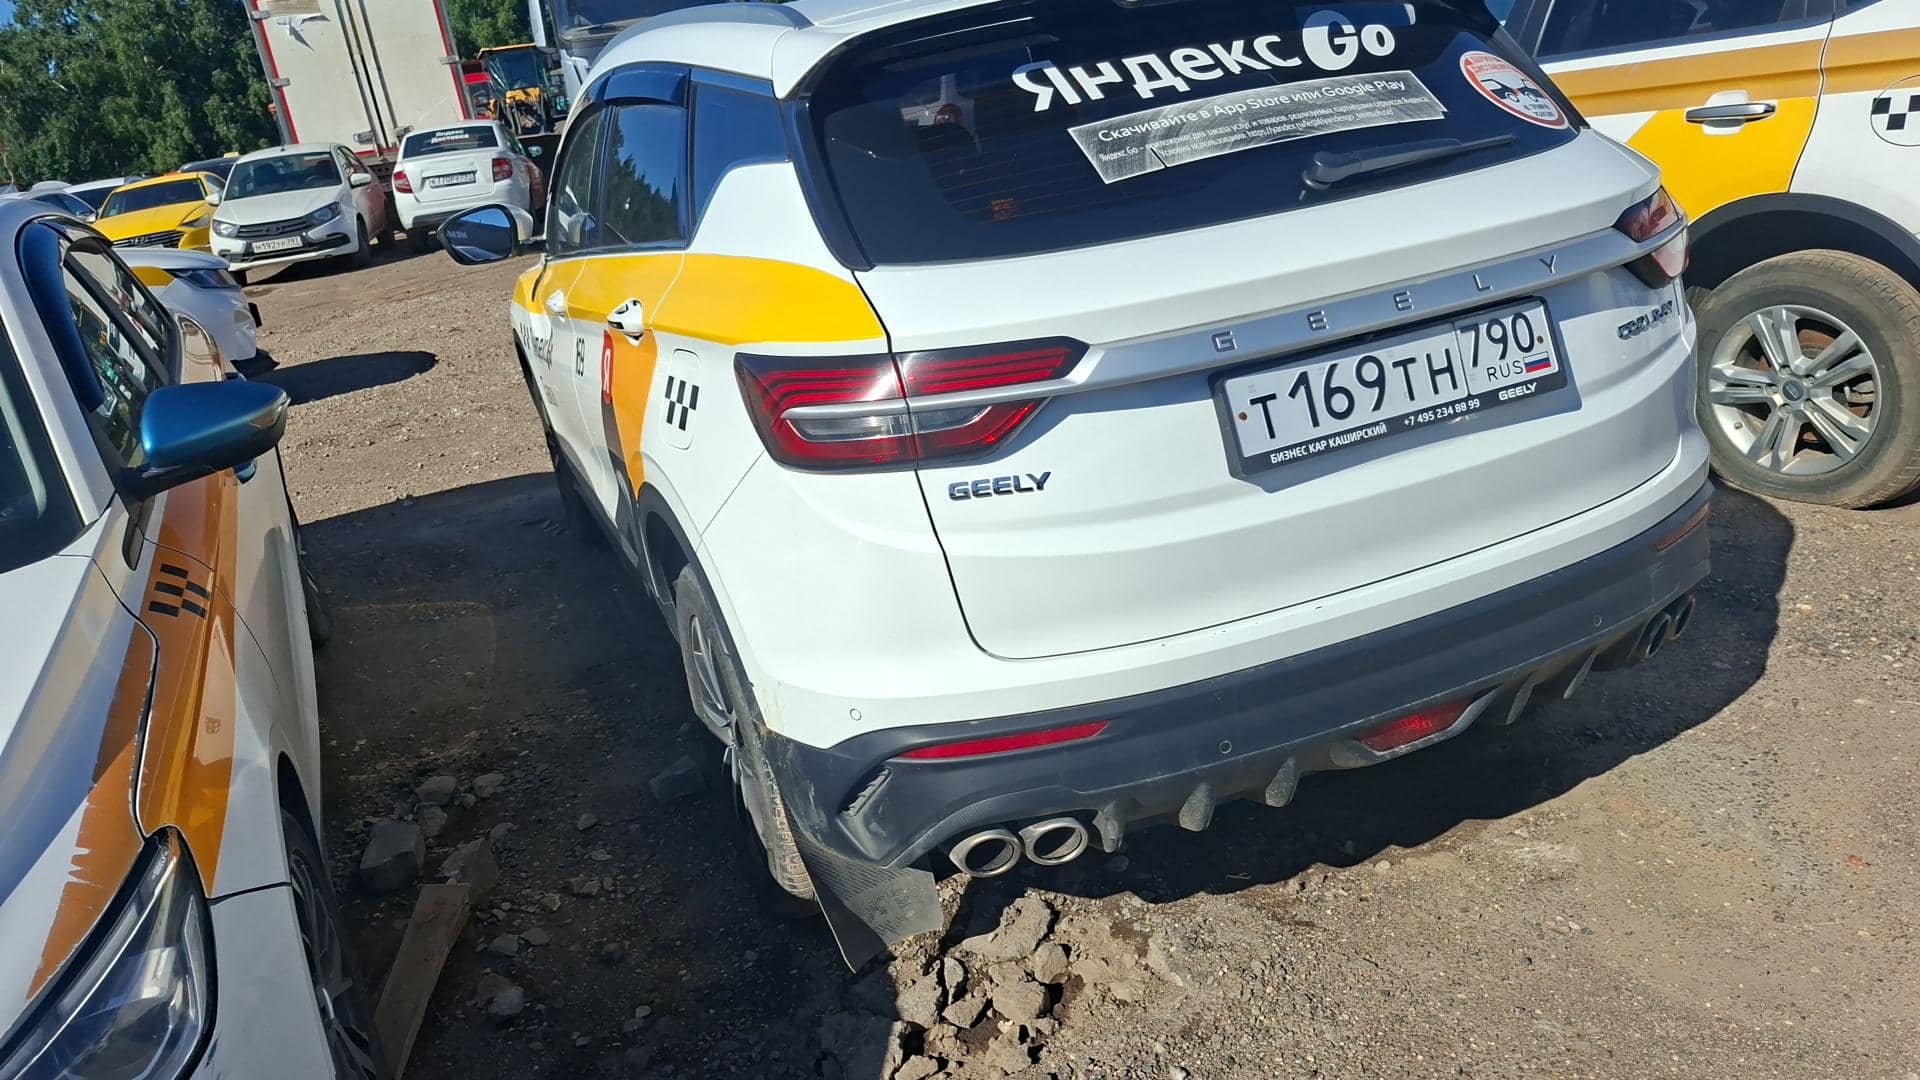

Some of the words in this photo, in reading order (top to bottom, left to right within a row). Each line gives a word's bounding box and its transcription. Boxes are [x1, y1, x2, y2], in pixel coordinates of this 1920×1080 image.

[1012, 35, 1301, 112] Яндекс
[1302, 10, 1396, 71] Go
[1098, 112, 1199, 142] Скачивайте
[1198, 109, 1212, 118] в
[1212, 102, 1247, 117] App
[1246, 95, 1291, 110] Store
[1290, 90, 1322, 103] или
[1321, 82, 1377, 97] Google
[1376, 79, 1406, 92] Play
[1211, 253, 1559, 353] GEELY
[1458, 311, 1535, 368] 790
[1486, 358, 1525, 384] RUS
[1498, 381, 1538, 401] GEELY
[1403, 415, 1415, 427] +7
[1416, 410, 1435, 423] 495
[1435, 405, 1455, 419] 234
[1454, 402, 1468, 414] 88
[1467, 398, 1481, 411] 99
[1270, 445, 1308, 464] БИЗНЕС
[1308, 439, 1329, 455] КАР
[1328, 422, 1388, 448] КАШИРСКИЙ
[948, 471, 1052, 502] GEELY
